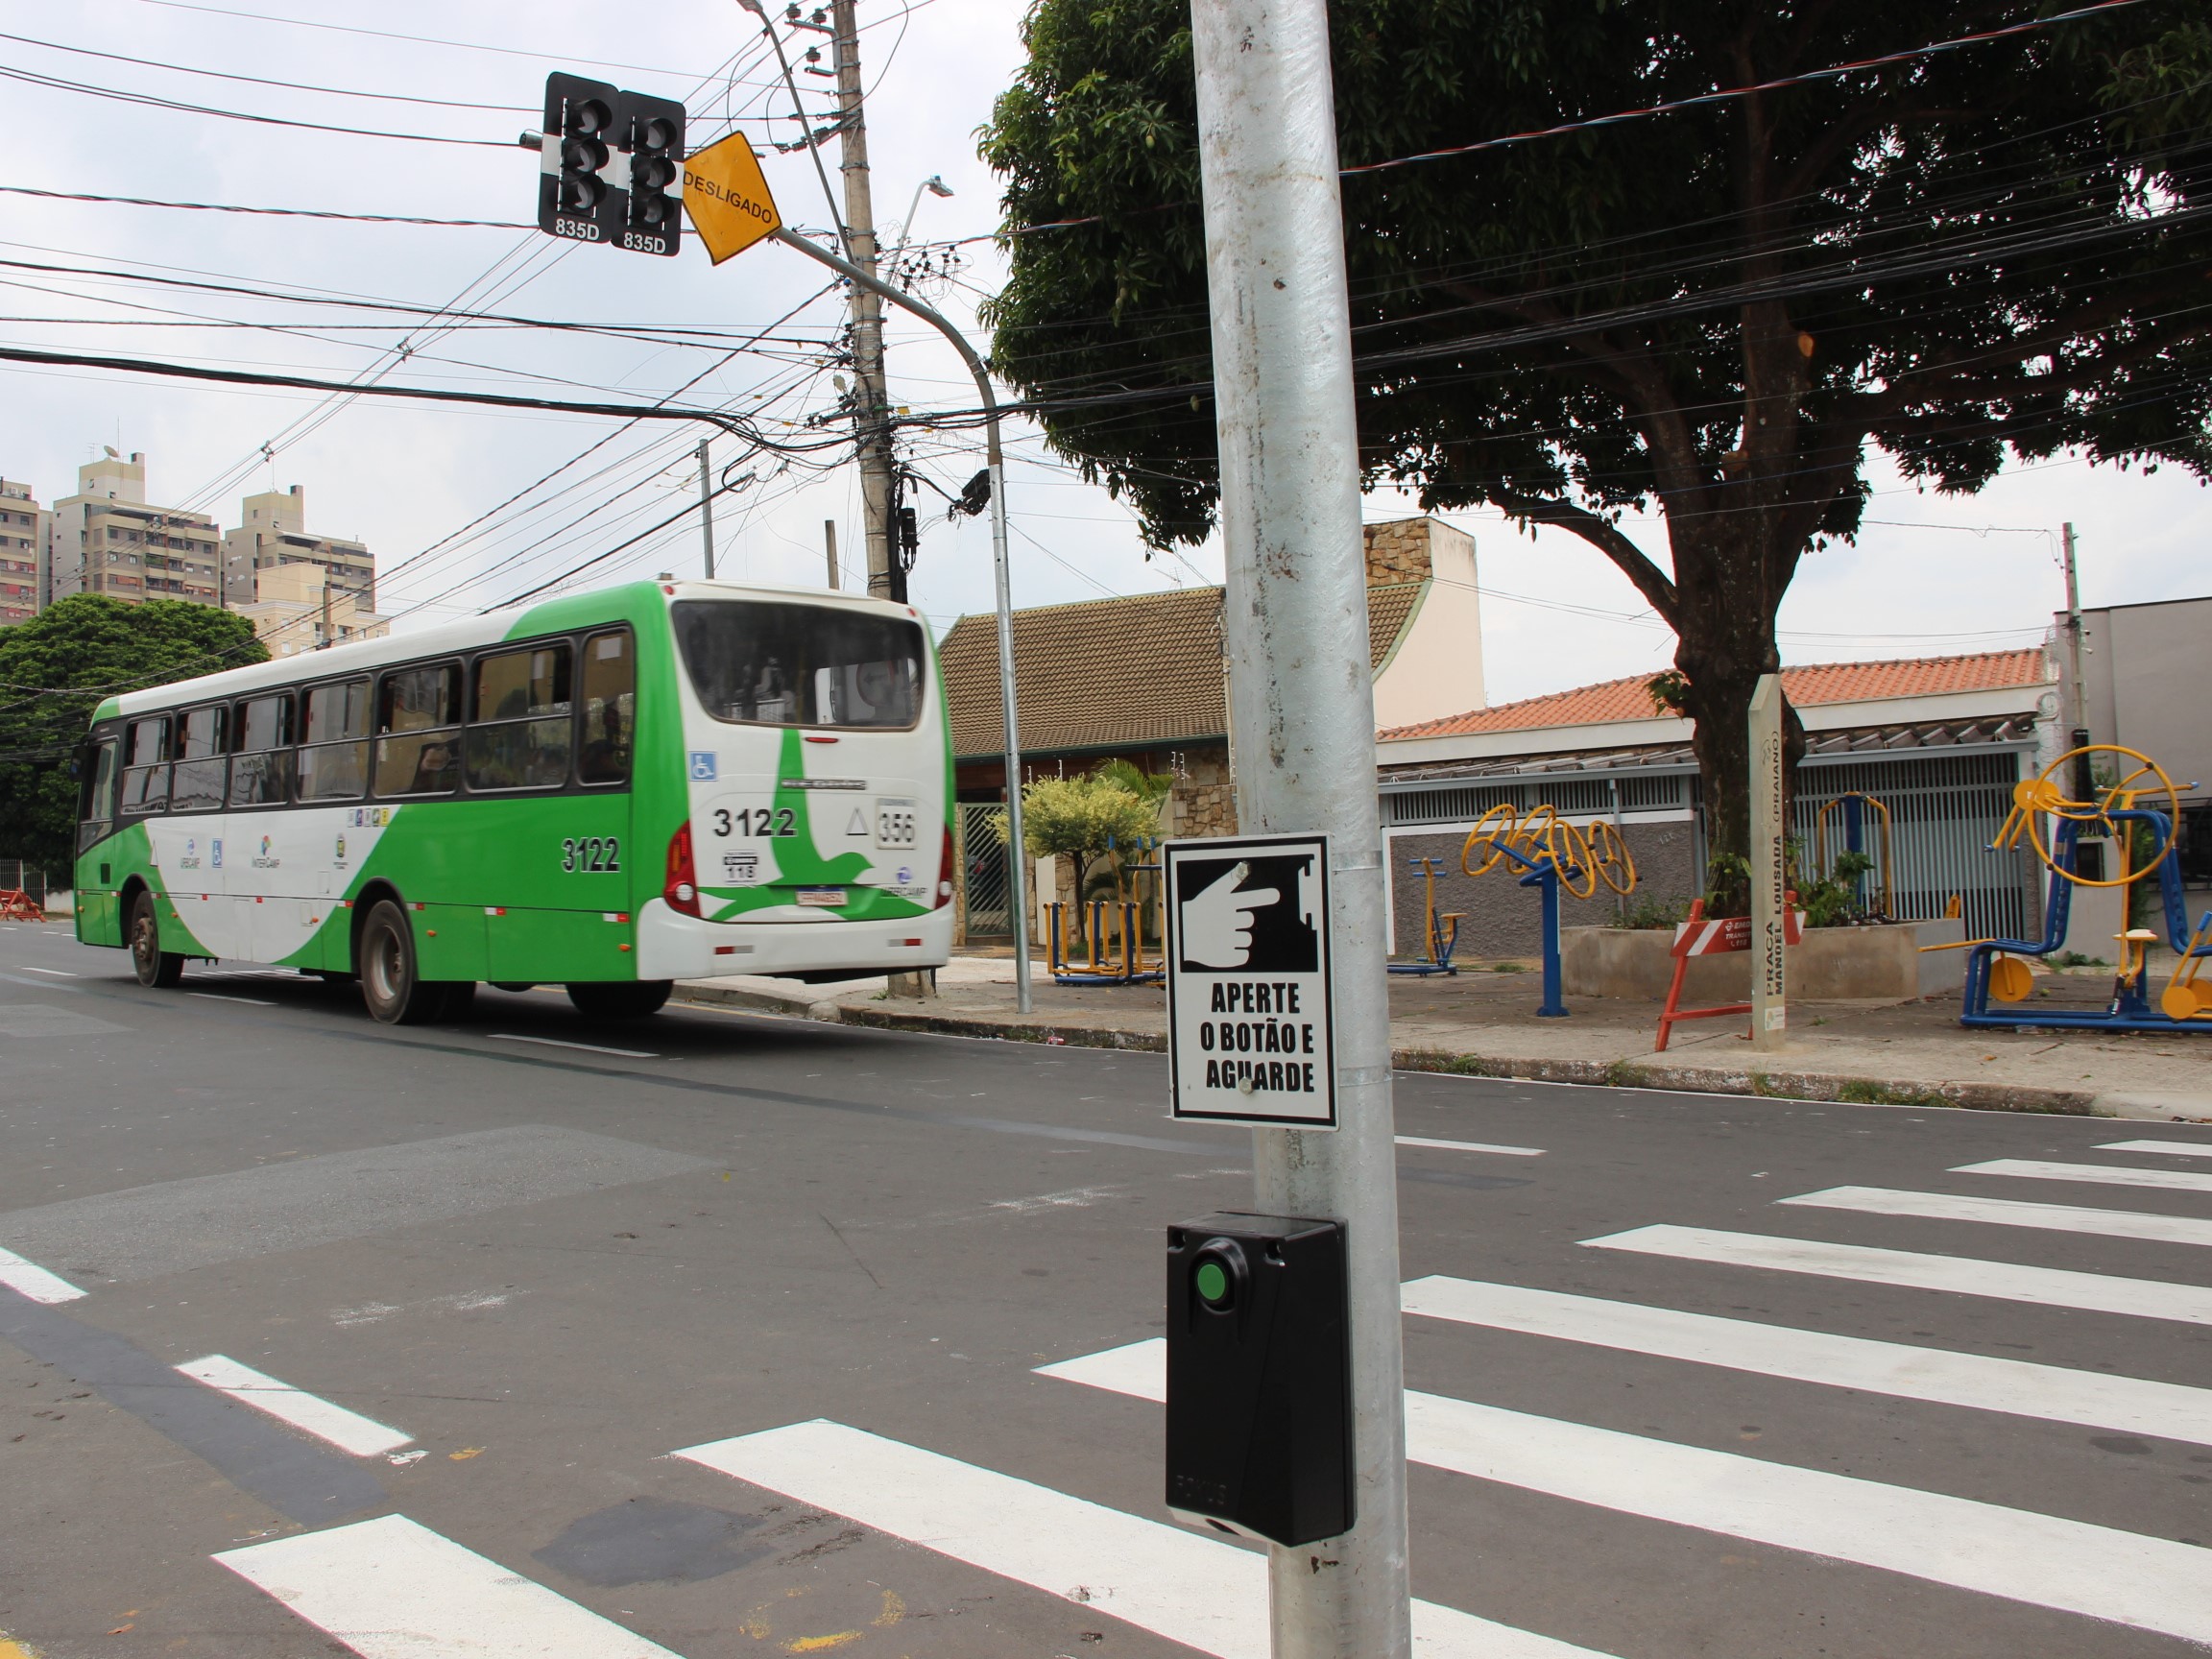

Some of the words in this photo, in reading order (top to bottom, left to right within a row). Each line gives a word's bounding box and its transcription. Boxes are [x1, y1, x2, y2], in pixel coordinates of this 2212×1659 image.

[683, 170, 772, 224] DESLIGADO
[555, 218, 600, 241] 835D
[623, 231, 666, 254] 835D
[1771, 731, 1780, 823] (PRAIANO)
[714, 808, 798, 838] 3122
[878, 813, 915, 843] 356
[561, 837, 622, 873] 3122
[727, 866, 756, 878] 118
[1211, 982, 1300, 1014] APERTE
[1200, 1022, 1214, 1051] O
[1220, 1018, 1296, 1054] BOTÃO
[1302, 1023, 1314, 1054] E
[1206, 1059, 1314, 1093] AGUARDE
